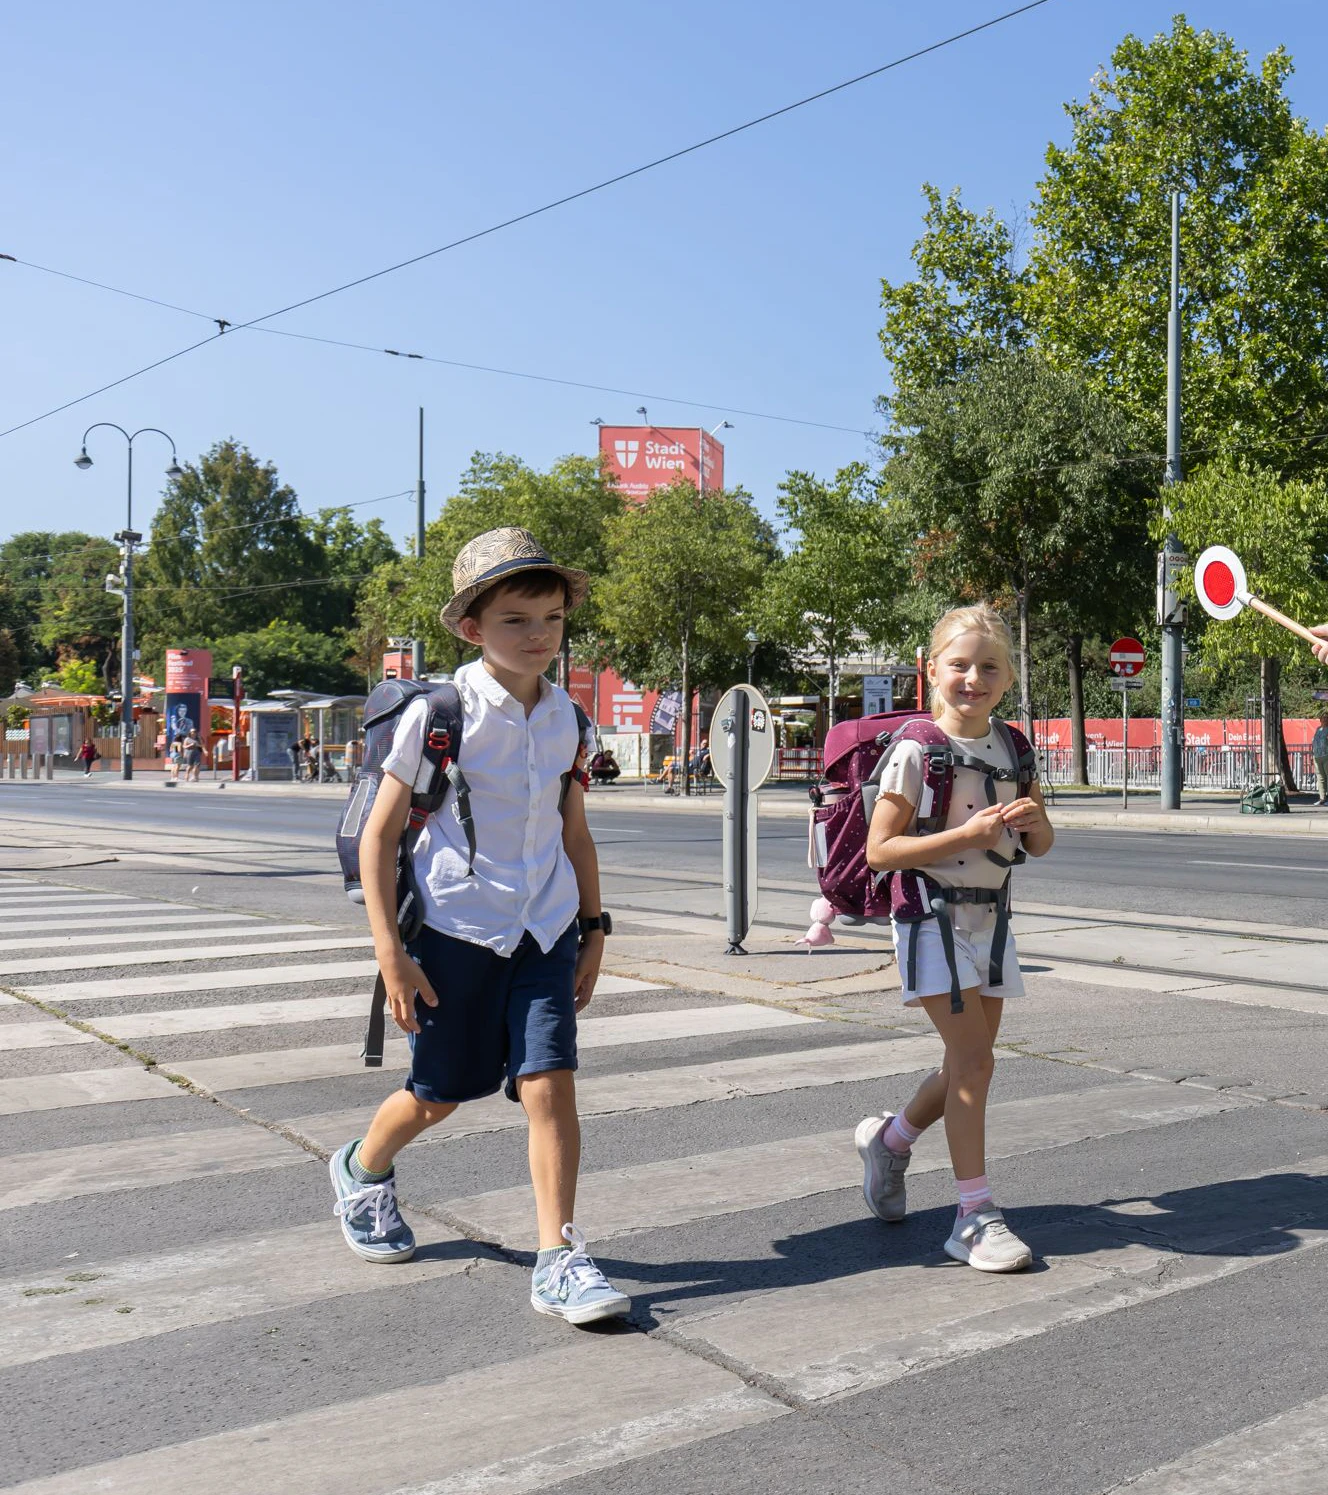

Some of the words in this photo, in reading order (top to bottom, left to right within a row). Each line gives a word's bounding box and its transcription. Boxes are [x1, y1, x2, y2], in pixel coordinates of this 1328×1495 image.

[645, 441, 685, 456] Stadt
[645, 455, 685, 469] Wien
[1186, 732, 1211, 746] Stadt
